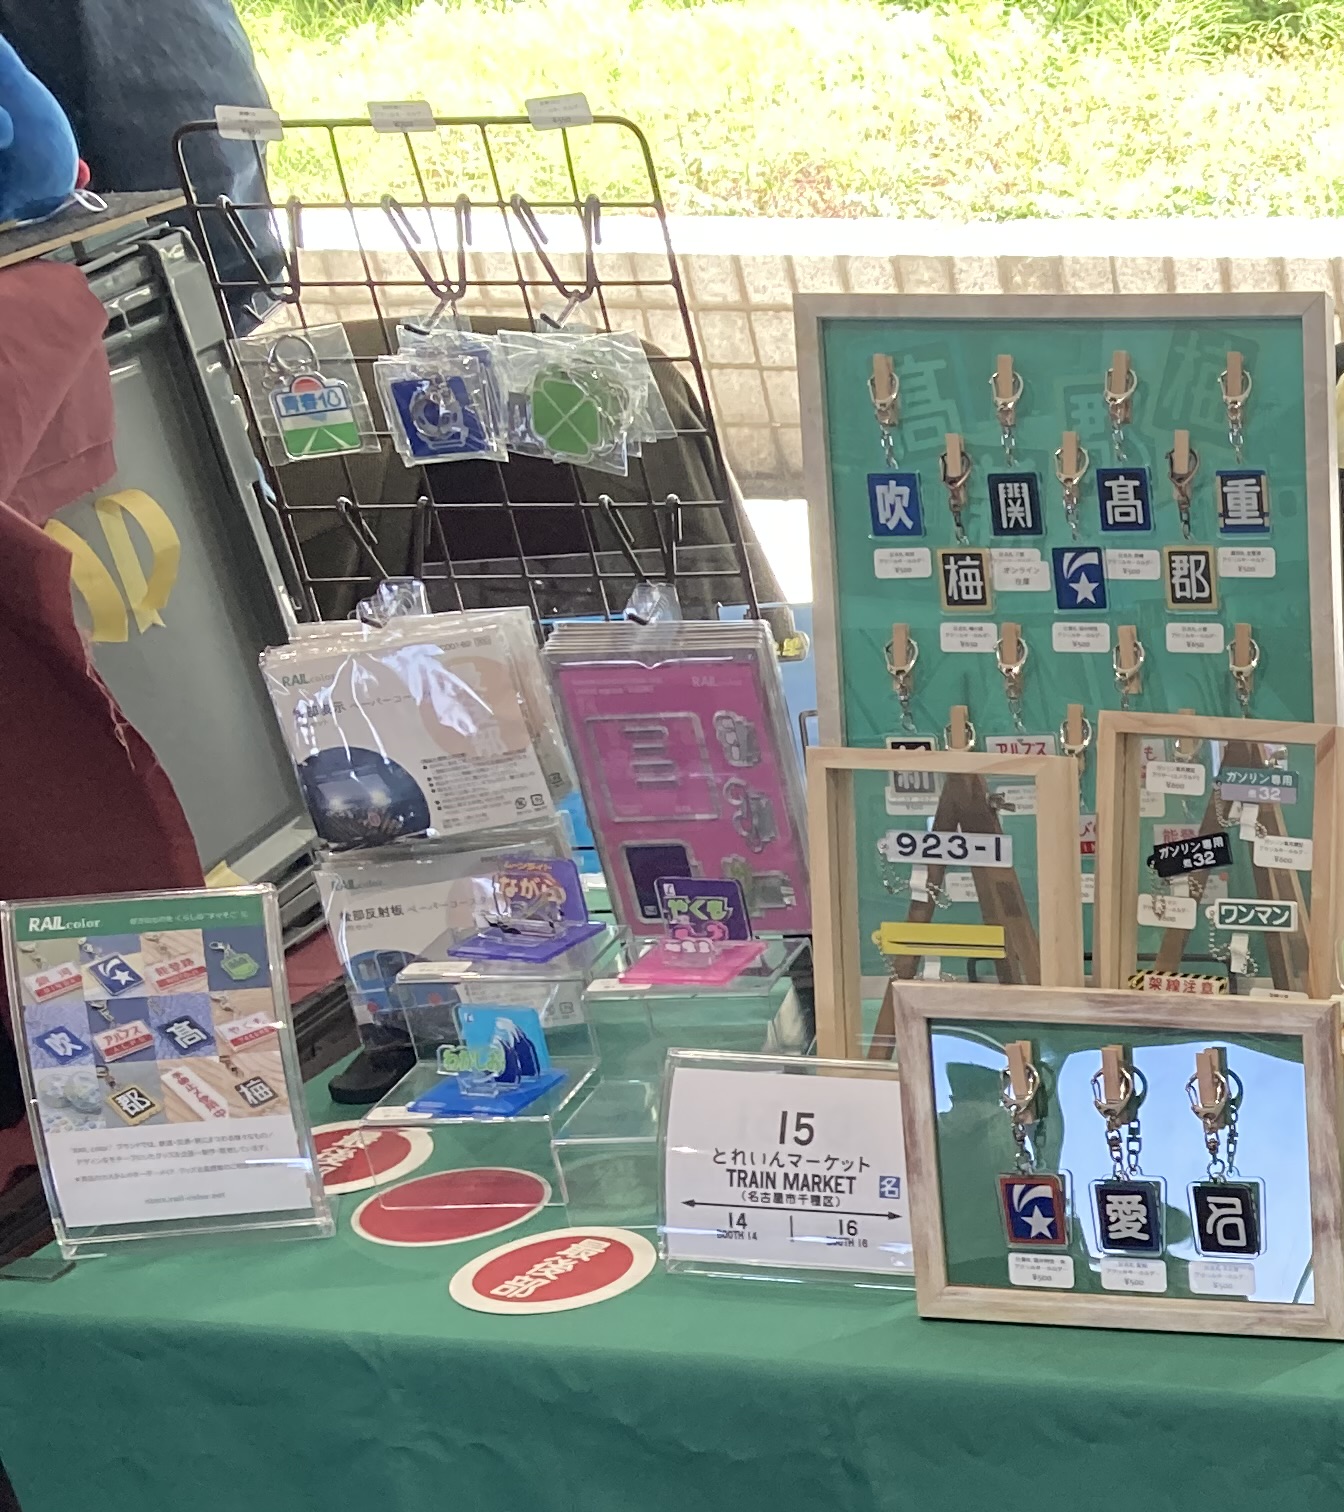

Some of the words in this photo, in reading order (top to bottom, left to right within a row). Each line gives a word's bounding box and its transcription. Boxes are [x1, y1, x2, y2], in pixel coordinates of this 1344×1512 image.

[874, 478, 915, 531] 吹
[998, 481, 1033, 529] 関
[1222, 477, 1263, 526] 重
[944, 555, 984, 601] 梅
[1170, 554, 1211, 600] 郡
[282, 673, 310, 687] RAIL
[293, 701, 347, 719] 部表示
[1226, 771, 1293, 788] ガソリン専用
[896, 832, 1002, 862] 923-1
[1158, 836, 1225, 860] ガソリン専用
[28, 916, 65, 932] RAIL
[1220, 904, 1290, 925] ワンマン
[778, 1110, 816, 1147] 15
[712, 1147, 871, 1173] とれいんマーケット
[725, 1168, 777, 1190] TRAIN
[783, 1172, 857, 1195] MARKET
[879, 1177, 899, 1198] 名
[728, 1212, 748, 1230] 14
[838, 1219, 859, 1236] 16
[1105, 1194, 1151, 1242] 愛
[716, 1229, 744, 1241] BOOTH
[747, 1230, 758, 1241] 14
